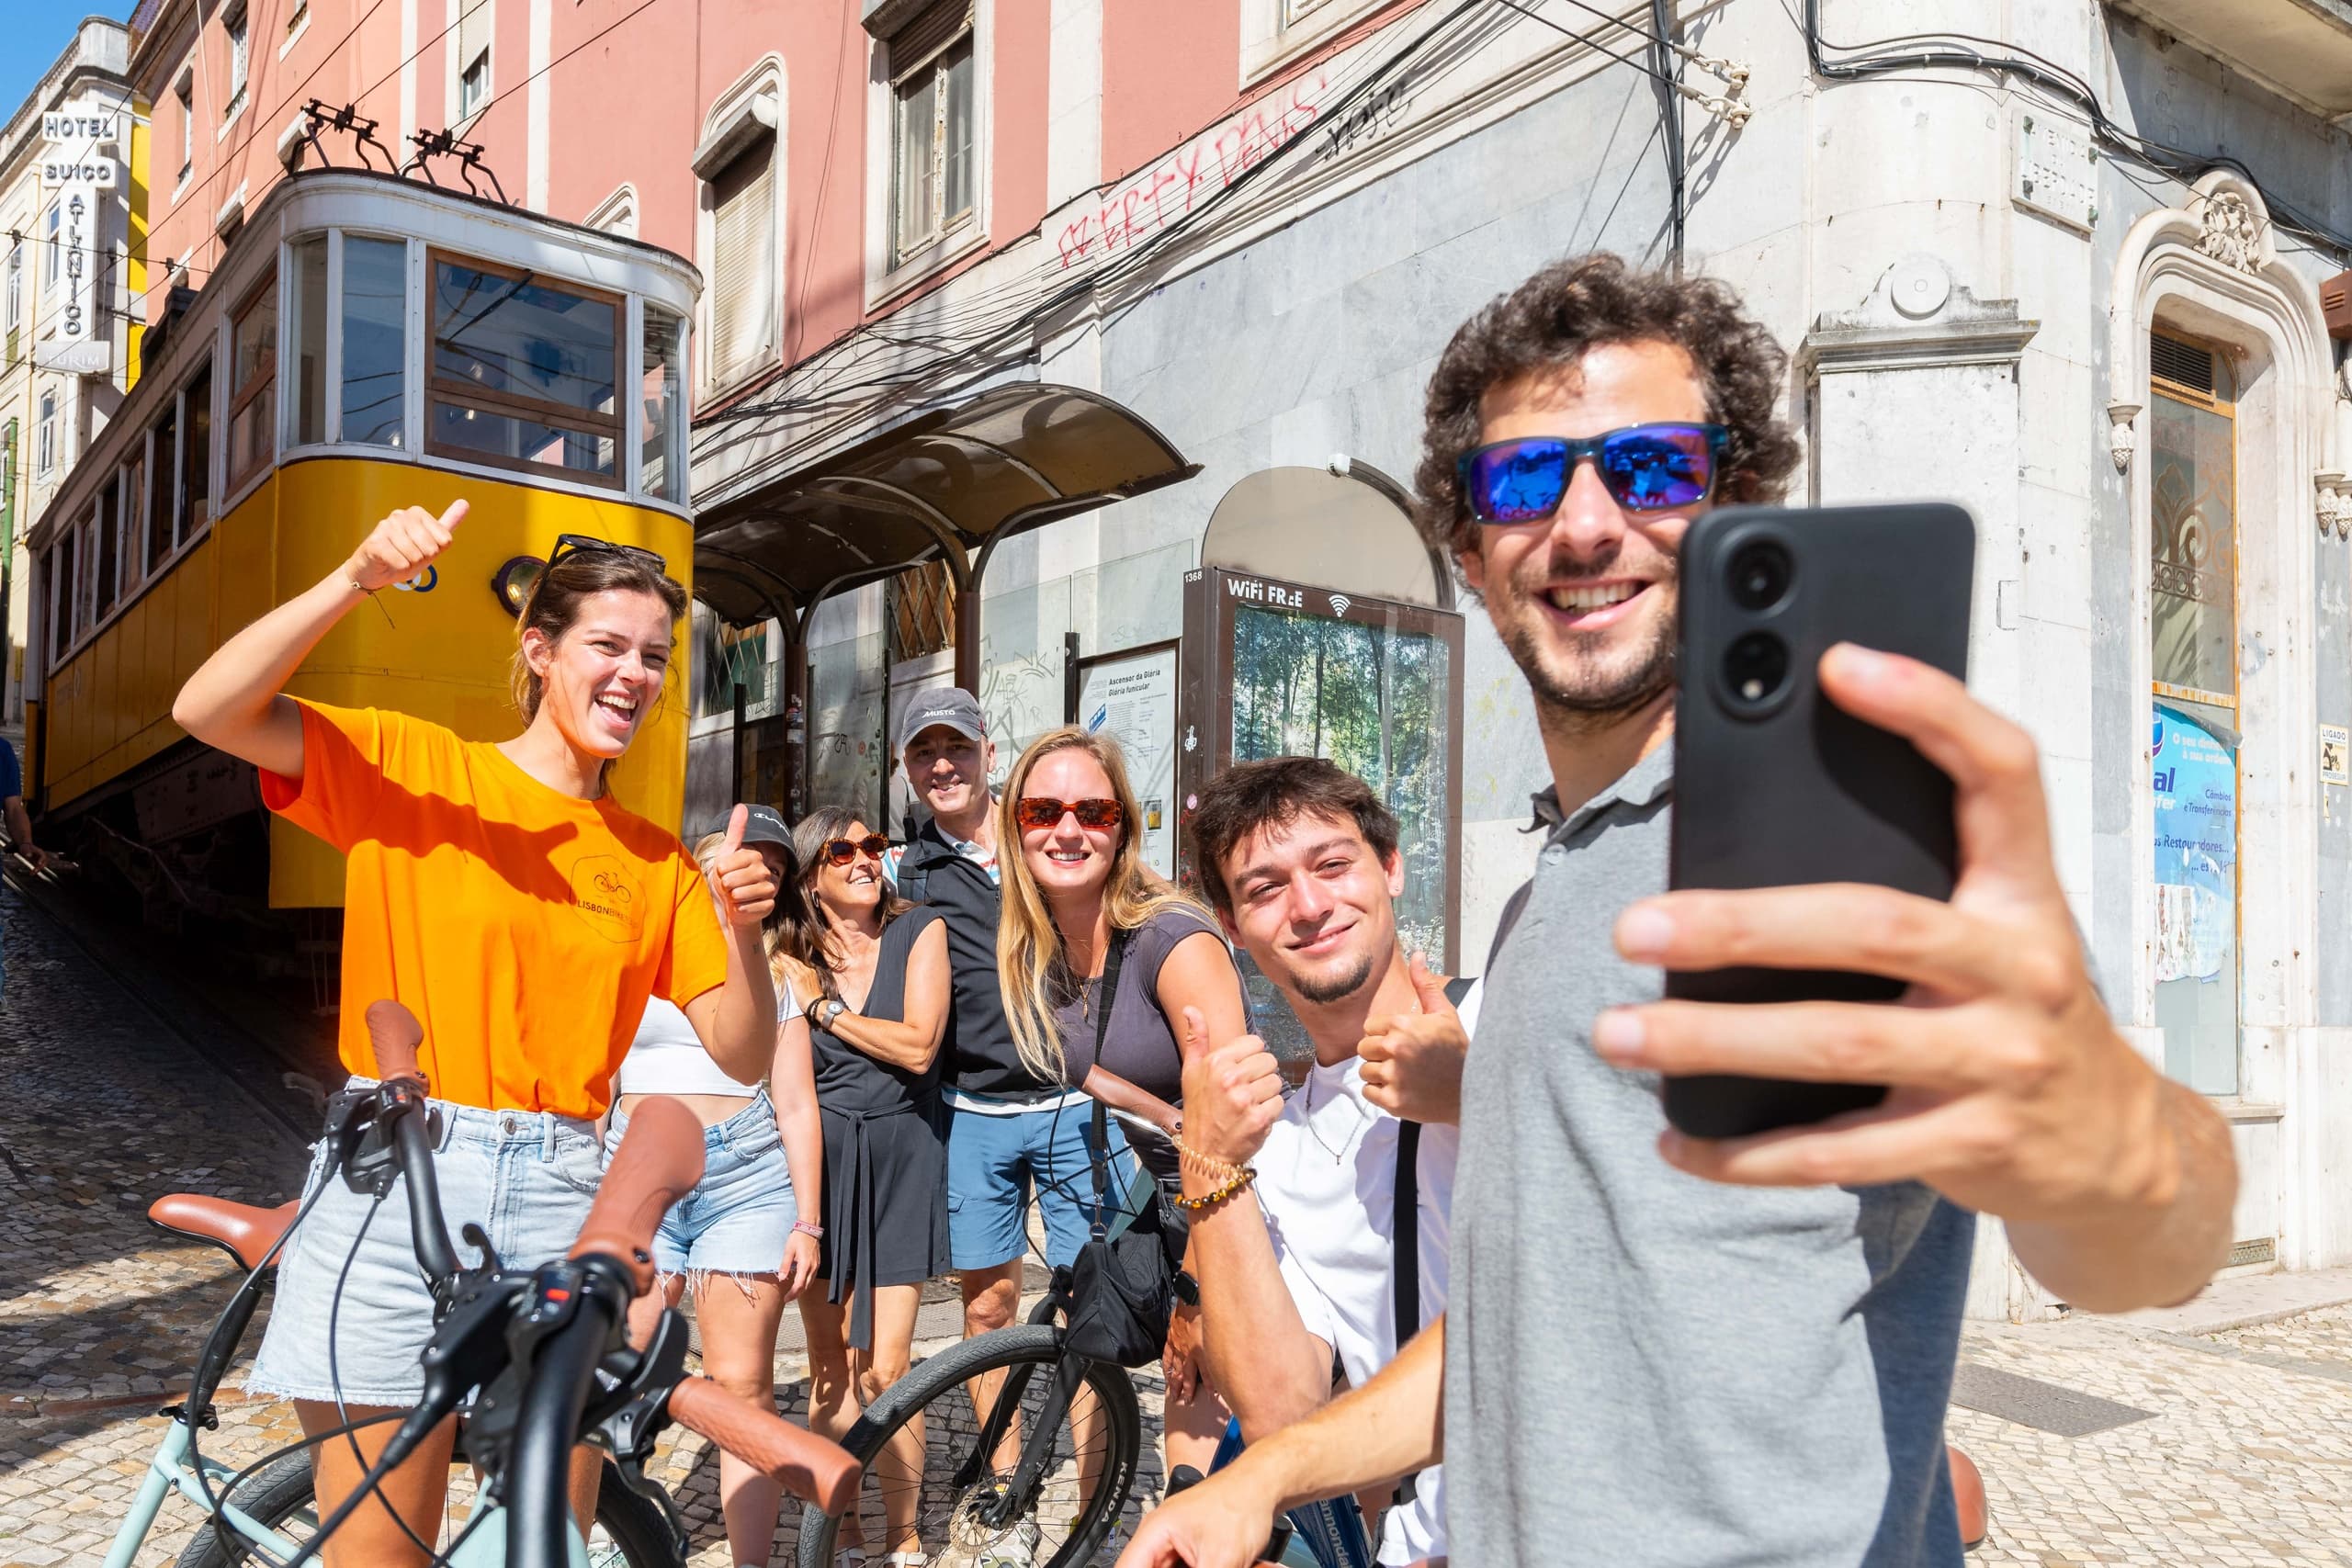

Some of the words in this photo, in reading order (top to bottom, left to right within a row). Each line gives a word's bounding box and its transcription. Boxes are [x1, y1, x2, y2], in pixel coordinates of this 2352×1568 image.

[44, 117, 114, 138] HOTEL
[44, 164, 111, 183] SUIÇO
[1184, 570, 1203, 583] 1368
[1227, 578, 1263, 601] WiFi
[1108, 674, 1135, 686] Ascensor
[1136, 672, 1143, 681] da
[1143, 669, 1161, 680] Glória
[1107, 688, 1125, 697] Glória
[1125, 682, 1150, 696] funicular
[922, 709, 956, 718] MUSTO
[2322, 729, 2346, 740] LIGADO
[2154, 767, 2177, 793] al
[2205, 788, 2232, 802] Câmbios
[1101, 1461, 1128, 1523] KENDA
